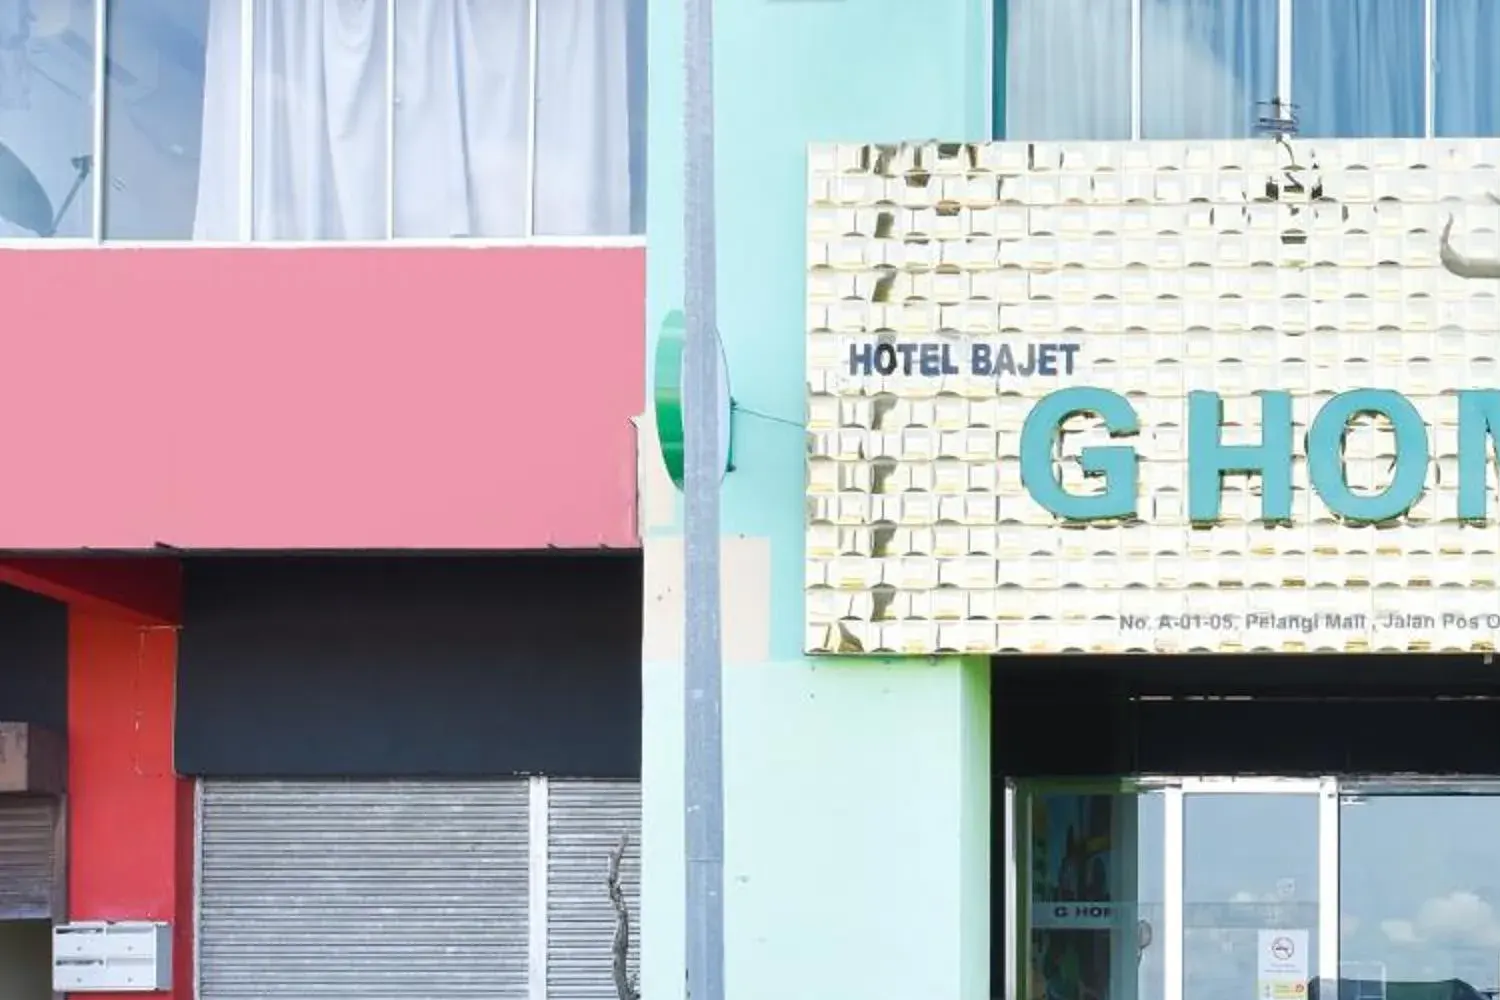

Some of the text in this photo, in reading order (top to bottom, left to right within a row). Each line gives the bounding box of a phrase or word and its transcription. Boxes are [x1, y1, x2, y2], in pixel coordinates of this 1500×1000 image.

[849, 343, 1081, 376] HOTEL BAJET
[1019, 385, 1141, 523] G
[1119, 614, 1153, 631] No.
[1245, 612, 1320, 633] Pelangi
[1383, 613, 1435, 629] Jalan
[1442, 613, 1479, 630] Pos
